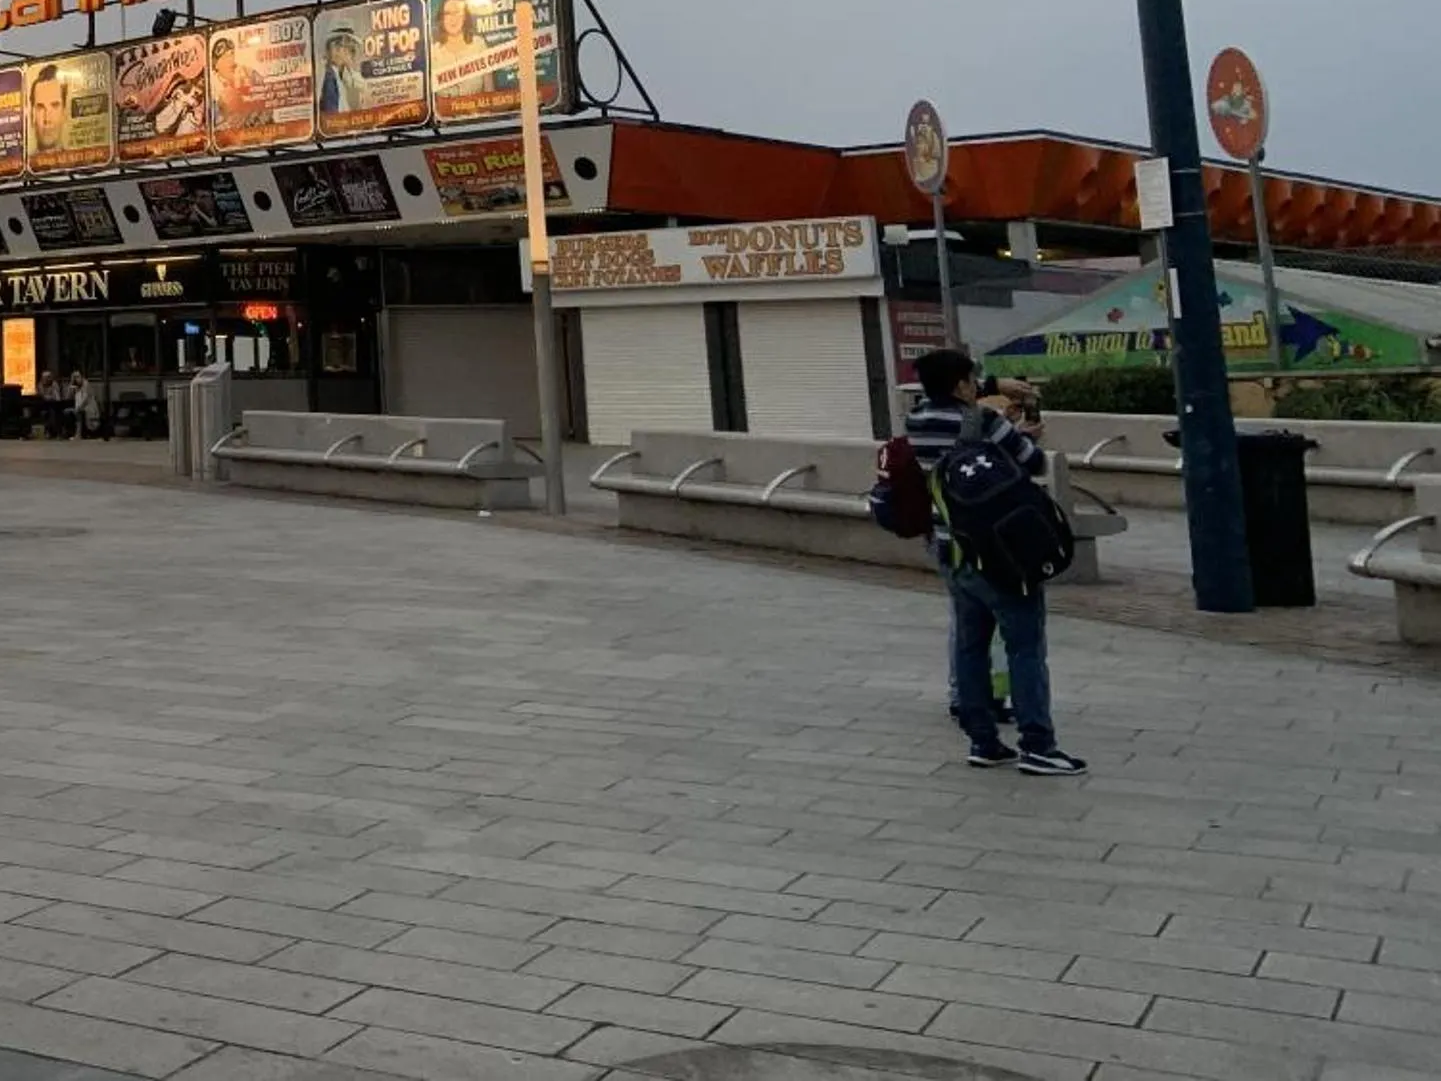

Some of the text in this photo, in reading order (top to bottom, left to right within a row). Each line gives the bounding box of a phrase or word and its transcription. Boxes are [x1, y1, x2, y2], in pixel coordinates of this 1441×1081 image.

[371, 4, 410, 31] KING
[476, 6, 550, 33] MILLN
[364, 27, 420, 56] OF POP
[484, 151, 526, 171] Rid
[727, 220, 864, 253] DONUTS
[219, 262, 255, 277] THE
[701, 248, 844, 280] WAFFLES
[8, 270, 111, 306] TAVERN
